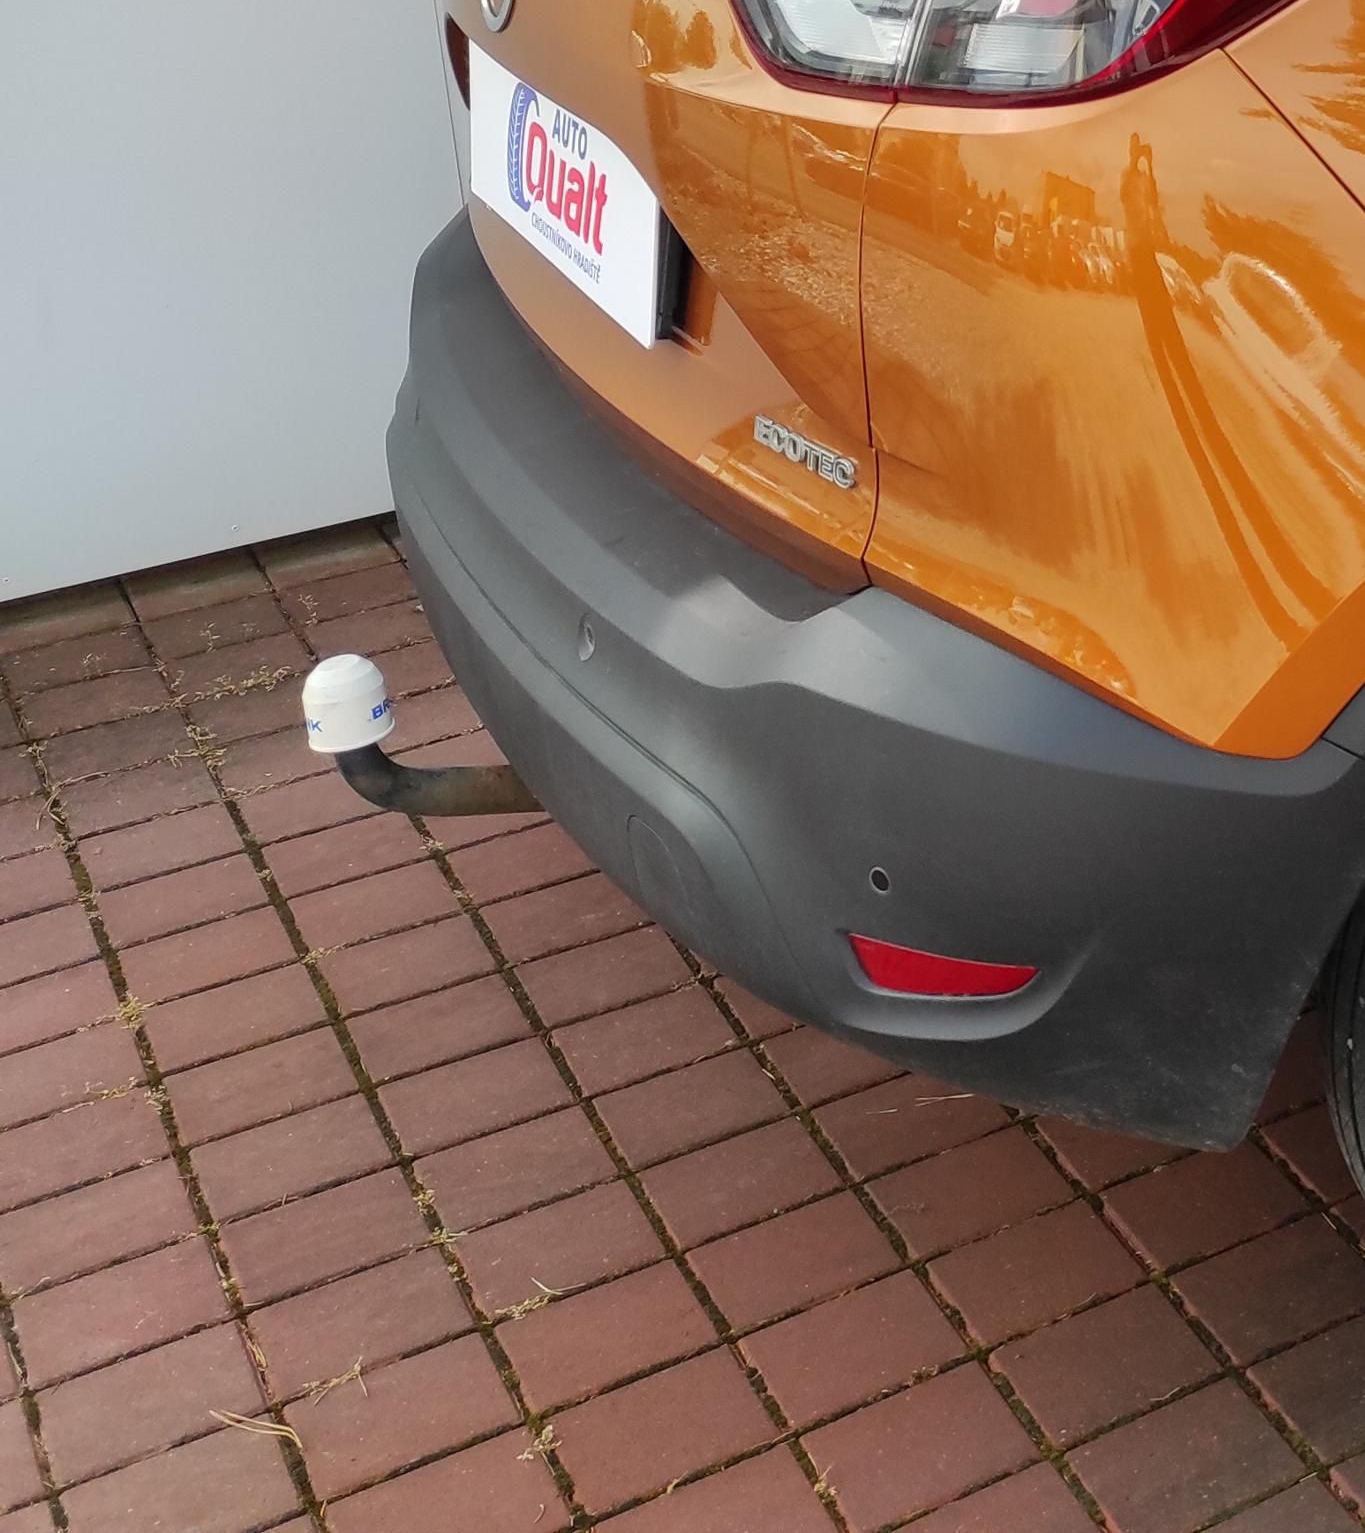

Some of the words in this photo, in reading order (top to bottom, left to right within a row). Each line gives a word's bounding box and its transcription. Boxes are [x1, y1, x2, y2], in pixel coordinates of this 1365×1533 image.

[552, 109, 588, 160] AUTO
[526, 122, 607, 256] Qualt
[754, 414, 857, 489] ECOTEC
